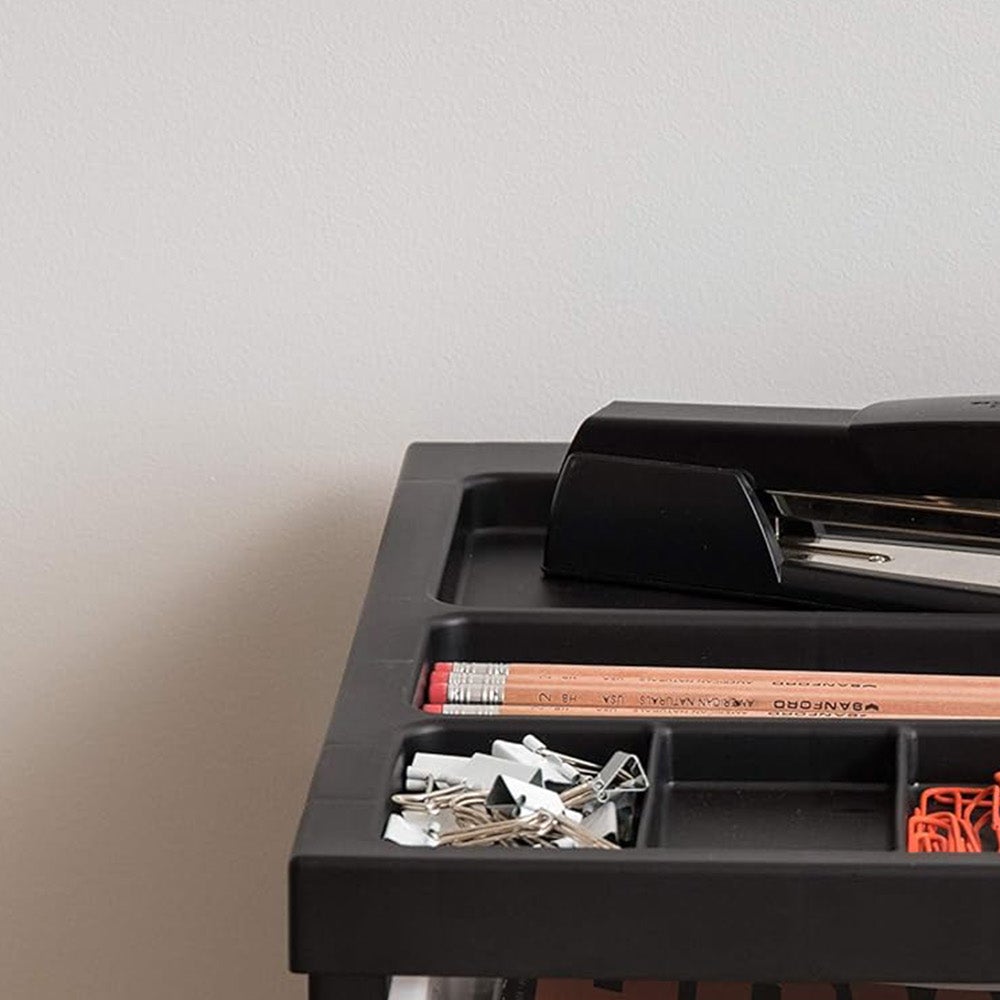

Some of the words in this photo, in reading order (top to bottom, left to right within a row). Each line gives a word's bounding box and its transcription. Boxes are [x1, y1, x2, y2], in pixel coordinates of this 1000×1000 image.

[538, 692, 552, 702] 2
[561, 693, 578, 704] HB
[602, 694, 625, 705] USA
[639, 694, 694, 707] NATURALS
[698, 697, 755, 708] AMERICAN
[773, 699, 863, 712] SANFORD
